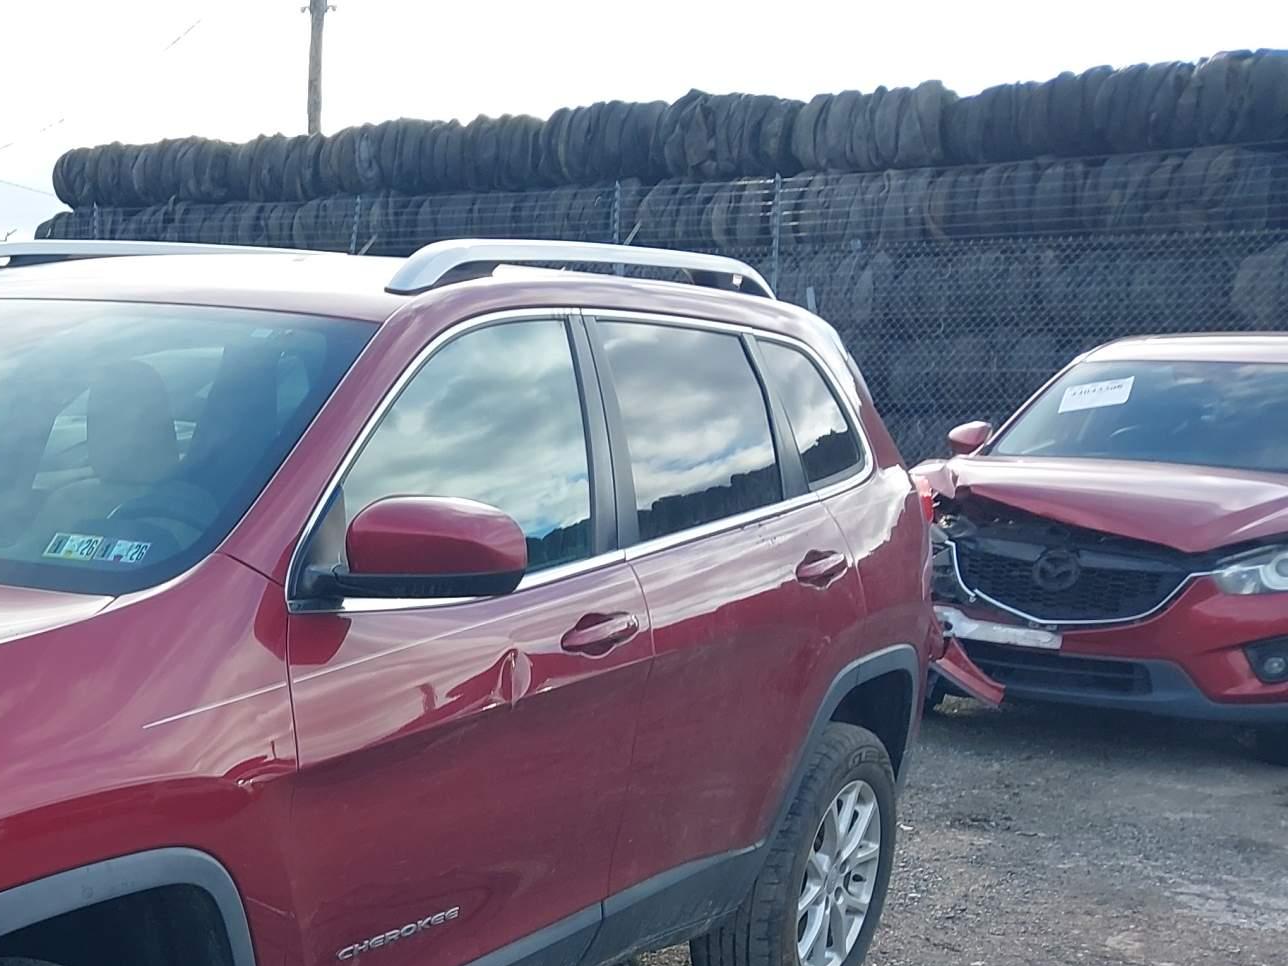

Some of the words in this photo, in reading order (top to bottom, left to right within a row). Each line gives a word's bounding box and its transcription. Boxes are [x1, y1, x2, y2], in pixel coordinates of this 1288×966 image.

[79, 539, 99, 557] 26
[129, 544, 148, 561] 26
[336, 906, 460, 960] CHEROKEE
